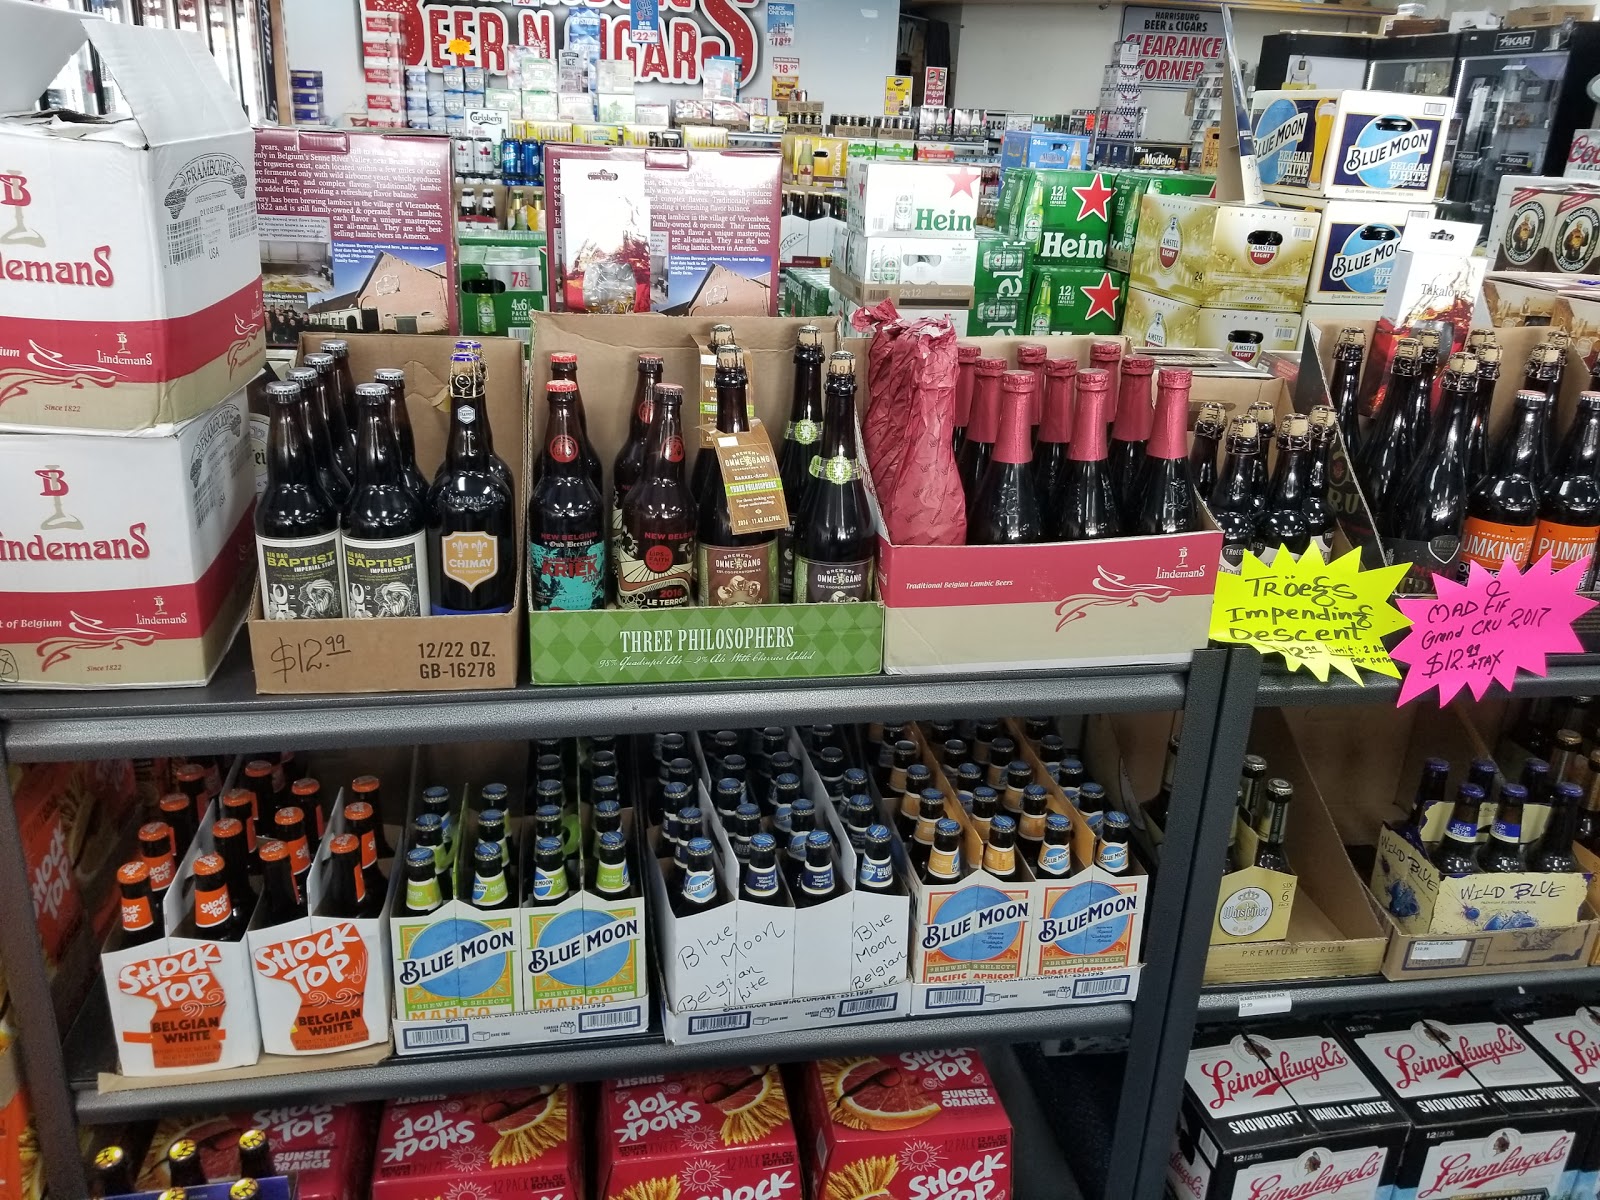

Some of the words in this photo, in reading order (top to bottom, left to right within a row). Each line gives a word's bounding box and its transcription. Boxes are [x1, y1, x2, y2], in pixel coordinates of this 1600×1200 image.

[1155, 12, 1200, 21] HARRISBURG
[1144, 20, 1166, 31] BEER
[1168, 23, 1174, 31] &
[1176, 22, 1208, 32] CIGARS
[632, 31, 656, 41] $22.99
[775, 64, 797, 74] $18.99
[470, 111, 502, 125] Carlsberg
[1275, 117, 1305, 148] MOON
[1144, 153, 1172, 165] Modelo
[1280, 150, 1312, 163] BELGIAN
[1347, 146, 1387, 171] BLUE
[1389, 133, 1429, 157] MOON
[1278, 161, 1309, 177] WHITE
[1390, 161, 1431, 172] BELGIAN
[1389, 170, 1428, 182] WHITE
[1051, 186, 1064, 196] 12
[1162, 238, 1179, 248] AMSTEL
[208, 246, 219, 260] USA
[1161, 249, 1175, 257] LIGHT
[1332, 254, 1373, 279] BLUE
[511, 272, 519, 287] 7
[1194, 271, 1203, 282] 24
[1058, 286, 1072, 296] 12
[511, 298, 527, 311] 4x6
[97, 350, 152, 366] LindemanS
[44, 403, 63, 412] Since
[64, 405, 81, 413] 1822
[734, 473, 768, 481] BARREL-AGED
[541, 532, 560, 541] NEW
[561, 531, 598, 541] BELGIUM
[644, 532, 666, 540] NEW
[1463, 534, 1525, 562] UMKING
[267, 551, 335, 567] BAPTIST
[348, 555, 413, 569] BAPTIST
[448, 557, 492, 569] CHIMAY
[294, 563, 321, 573] IMPERIAL
[370, 566, 397, 574] IMPERIAL
[397, 563, 414, 572] STOUT
[541, 560, 598, 579] KRIEK
[1156, 564, 1206, 580] LindemanS
[906, 581, 943, 590] Traditional
[944, 581, 968, 590] Belgian
[969, 579, 994, 589] Lambic
[995, 579, 1014, 588] Beers
[135, 612, 187, 625] LindemanS
[1226, 604, 1374, 629] Impending
[1427, 600, 1479, 624] MAD
[6, 618, 19, 629] of
[20, 618, 62, 630] Belgium
[1229, 621, 1367, 642] Descent
[1421, 625, 1465, 650] Grand
[1471, 618, 1502, 636] CRU
[1507, 607, 1552, 629] 2017
[619, 629, 673, 653] THREE
[677, 625, 794, 651] PHILOSOPHERS
[270, 634, 351, 683] $12.99
[418, 642, 464, 660] 12/22
[470, 641, 496, 657] OZ.
[786, 650, 816, 662] Added
[87, 664, 104, 672] Since
[105, 664, 122, 672] 1822
[1421, 643, 1480, 679] $12.99
[419, 661, 496, 679] GB-16278
[1381, 834, 1406, 864] WILD
[1407, 853, 1439, 892] BLUE
[1282, 890, 1289, 902] 6
[1460, 883, 1505, 901] WILD
[1510, 880, 1566, 900] BLUE
[200, 892, 229, 914] SHOCK
[209, 902, 228, 918] TOP
[1222, 902, 1269, 920] Warsteiner
[922, 916, 972, 949] BLUE
[978, 902, 1029, 928] MOON
[1038, 911, 1089, 943] BLUE
[1088, 895, 1137, 921] MOON
[853, 912, 893, 943] Blue
[255, 923, 360, 978] SHOCK
[528, 940, 581, 974] BLUE
[586, 919, 639, 948] MOON
[677, 925, 733, 970] Blue
[721, 920, 785, 967] Moon
[855, 934, 897, 963] Moon
[1242, 948, 1299, 957] PREMIUM
[1305, 945, 1346, 954] VERUM
[400, 949, 455, 985] BLUE
[460, 930, 514, 962] MOON
[1089, 955, 1120, 963] SELECT
[119, 943, 222, 995] SHOCK
[283, 953, 350, 994] TOP
[851, 950, 908, 990] Belgian
[979, 963, 1012, 971] SELECT
[928, 972, 967, 983] PACIFIC
[973, 972, 1015, 980] APRICOT
[147, 973, 211, 1008] TOP
[592, 985, 630, 995] SELECT
[677, 965, 764, 1012] Belgian
[469, 998, 505, 1006] SELECT
[152, 1016, 219, 1033] BELGIAN
[298, 1008, 361, 1026] BELGIAN
[163, 1029, 211, 1044] WHITE
[308, 1021, 354, 1036] WHITE
[1385, 1027, 1526, 1089] Leinenkugel's
[923, 1057, 975, 1082] TOP
[1201, 1041, 1349, 1109] Leinenkugel's
[941, 1088, 989, 1100] SUNSET
[941, 1096, 996, 1108] ORANGE
[1416, 1094, 1490, 1114] SNOWDRIFT
[1498, 1089, 1537, 1104] VANILLA
[1537, 1085, 1578, 1100] PORTER
[621, 1091, 678, 1120] TOP
[394, 1109, 454, 1140] TOP
[613, 1100, 701, 1143] SHOCK
[1228, 1110, 1302, 1135] SNOWDRIFT
[1309, 1104, 1353, 1121] VANILLA
[1352, 1100, 1395, 1118] PORTER
[275, 1113, 334, 1143] TOP
[1426, 1130, 1437, 1139] 12
[381, 1120, 475, 1164] SHOCK
[273, 1149, 331, 1161] SUNSET
[739, 1154, 760, 1169] PACK
[762, 1157, 795, 1167] BOTTLES
[1234, 1154, 1244, 1163] 12
[274, 1159, 331, 1171] ORANGE
[1418, 1135, 1571, 1199] Leinenkugel's
[908, 1151, 1007, 1200] SHOCK
[505, 1176, 529, 1192] PACK
[531, 1179, 566, 1189] BOTTLES
